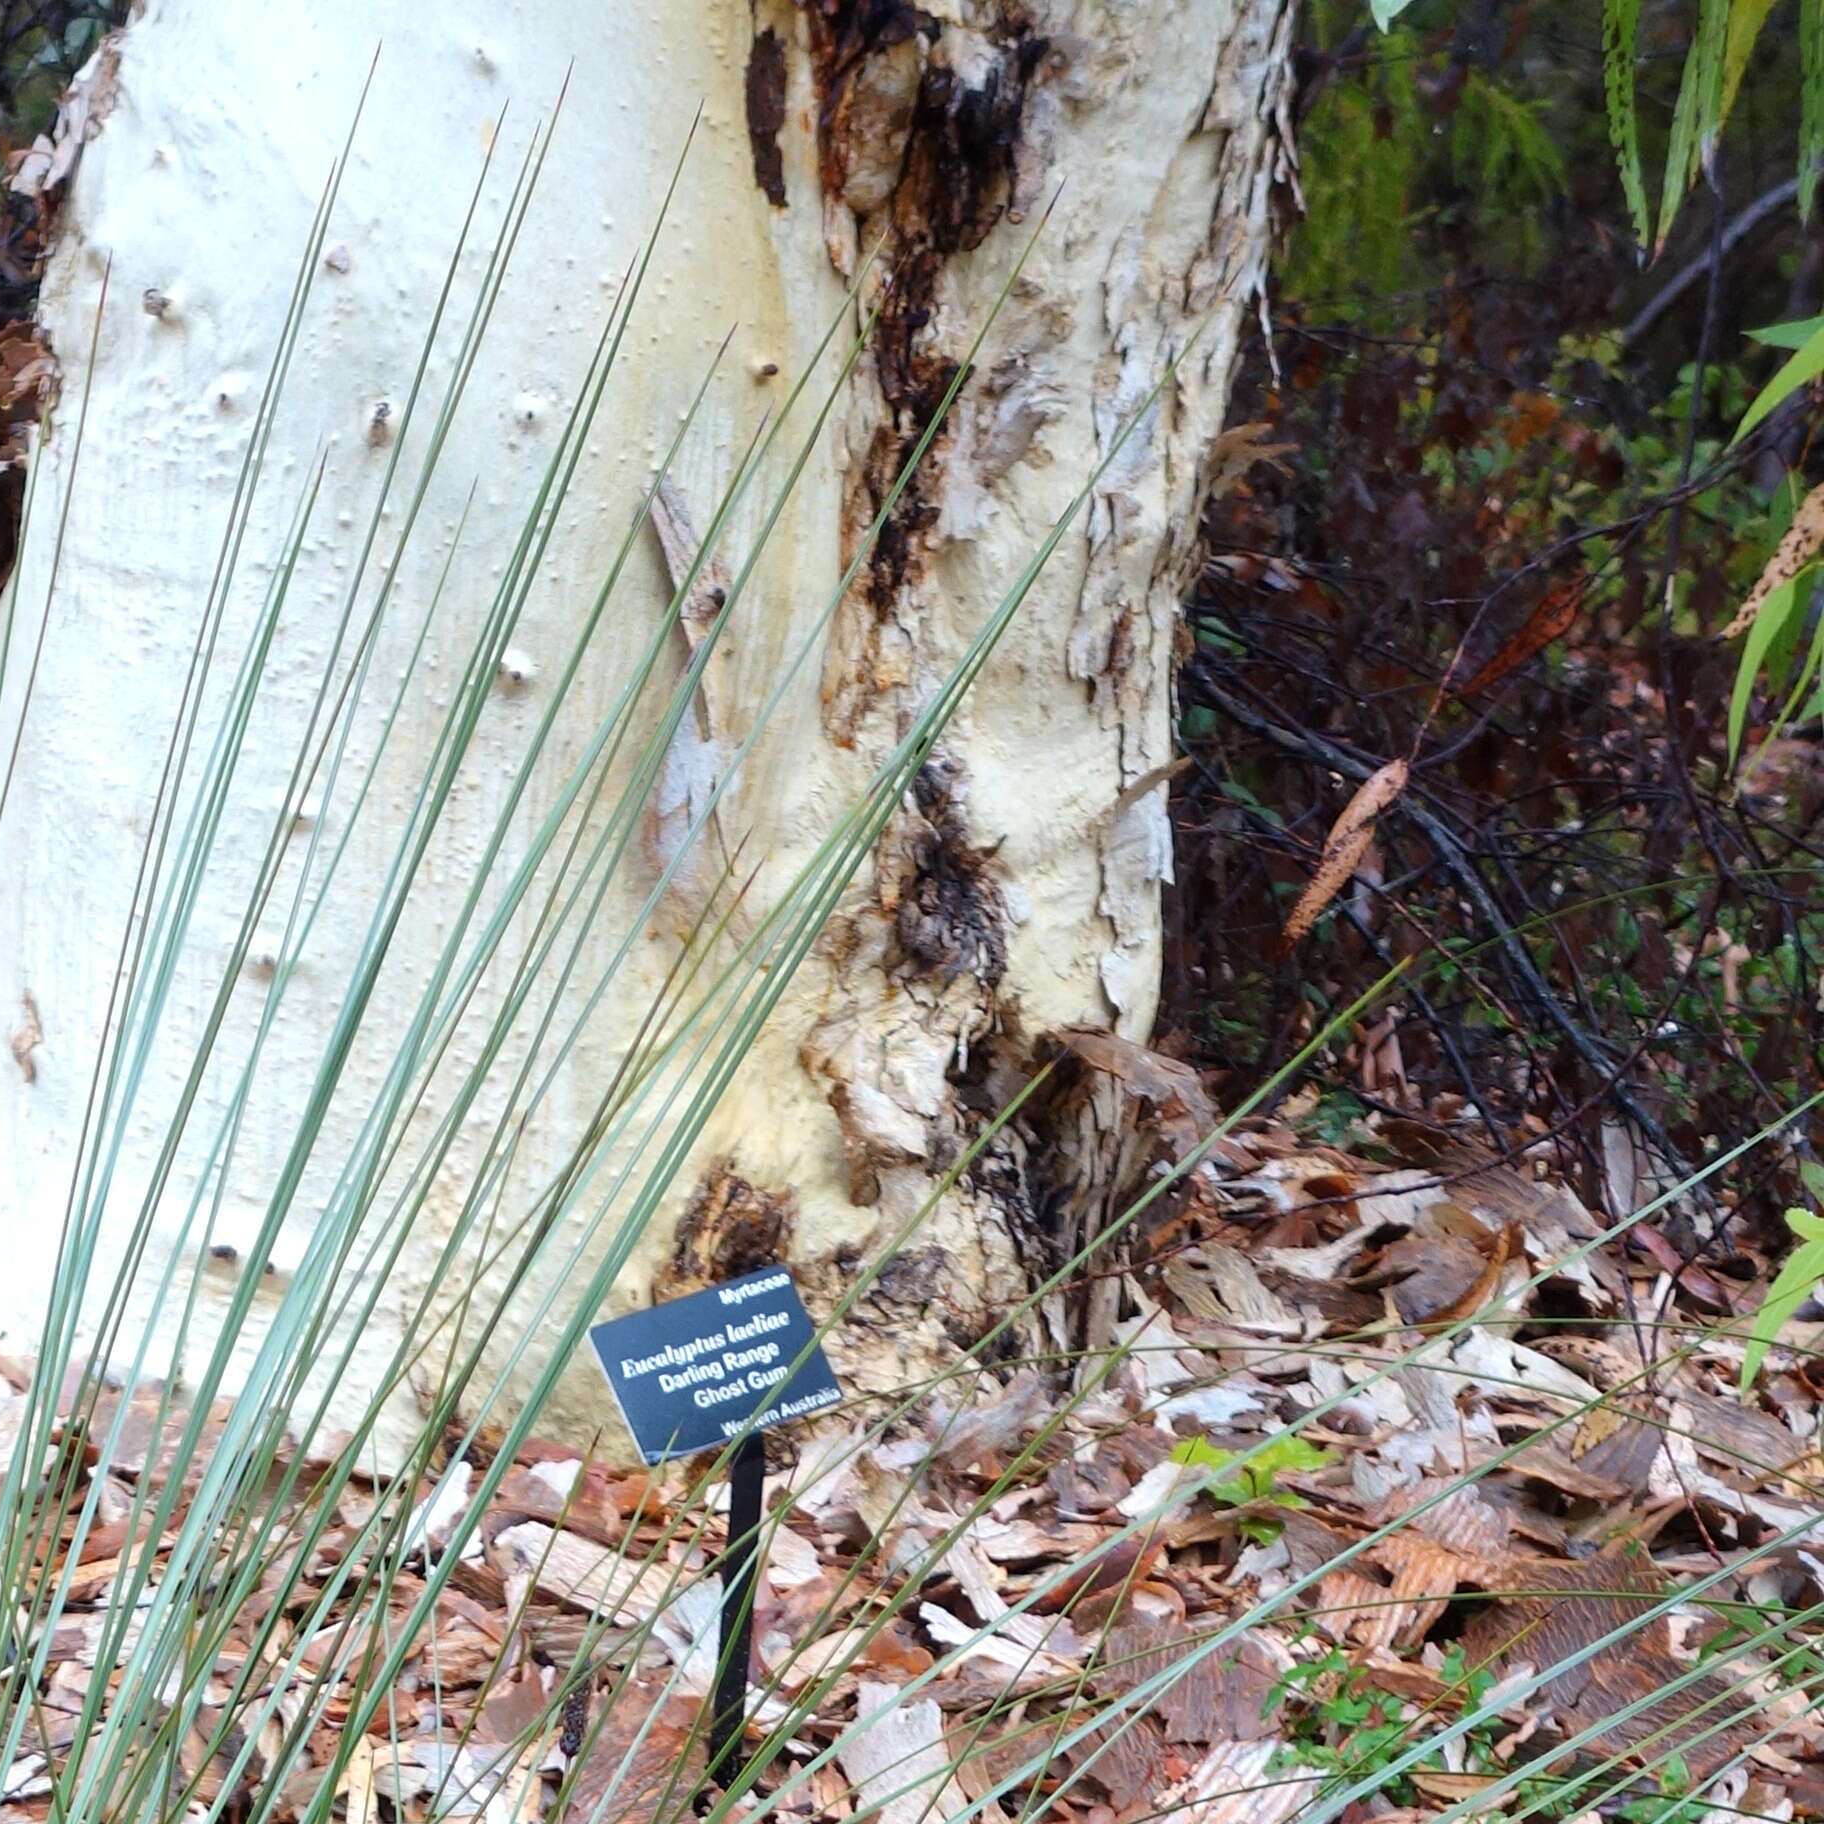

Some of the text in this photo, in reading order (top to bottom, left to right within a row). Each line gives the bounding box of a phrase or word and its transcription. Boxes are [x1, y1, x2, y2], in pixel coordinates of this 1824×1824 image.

[718, 1273, 791, 1305] Myrtaceae
[621, 1333, 726, 1378] Eucalyptus
[659, 1341, 780, 1393] Darling Range
[694, 1364, 790, 1408] Ghost Gum
[779, 1387, 842, 1418] Australia
